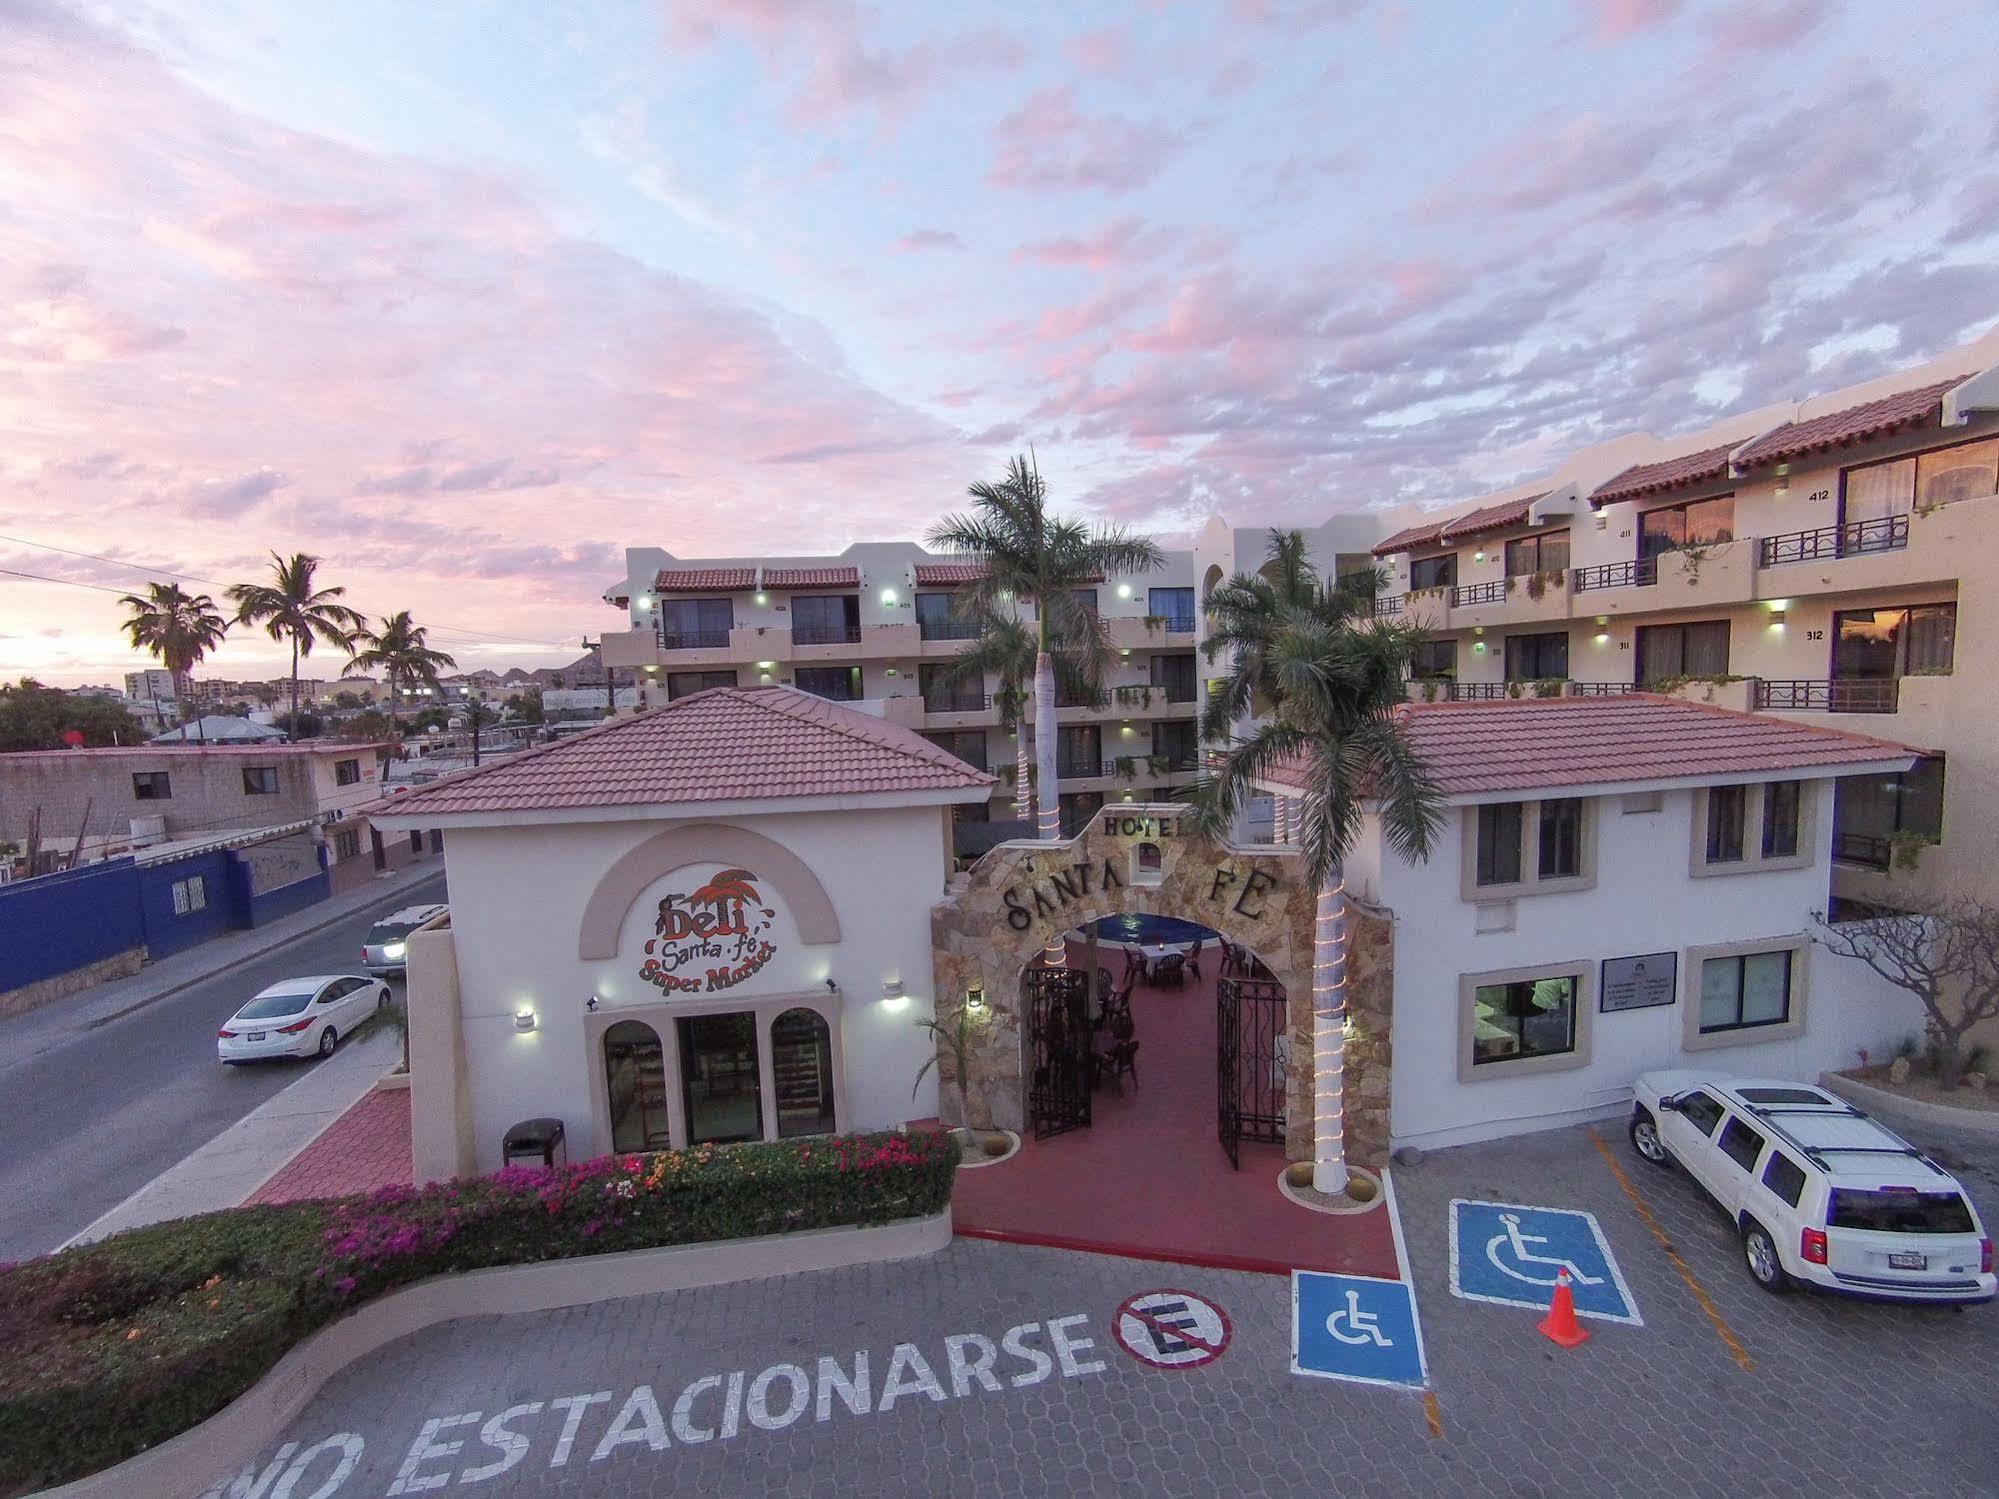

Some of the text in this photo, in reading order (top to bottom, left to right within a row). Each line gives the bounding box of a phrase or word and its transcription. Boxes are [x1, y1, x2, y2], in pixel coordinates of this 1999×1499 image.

[1808, 489, 1829, 502] 412
[1620, 529, 1631, 539] 411
[1619, 641, 1630, 651] 311
[1806, 630, 1823, 641] 312
[1104, 816, 1188, 838] HOTEL
[1003, 857, 1278, 931] SANTA FE
[660, 897, 749, 939] Deli
[638, 940, 777, 997] Super Market
[662, 937, 722, 974] Santa
[386, 1313, 1106, 1497] ESTACIONARSE
